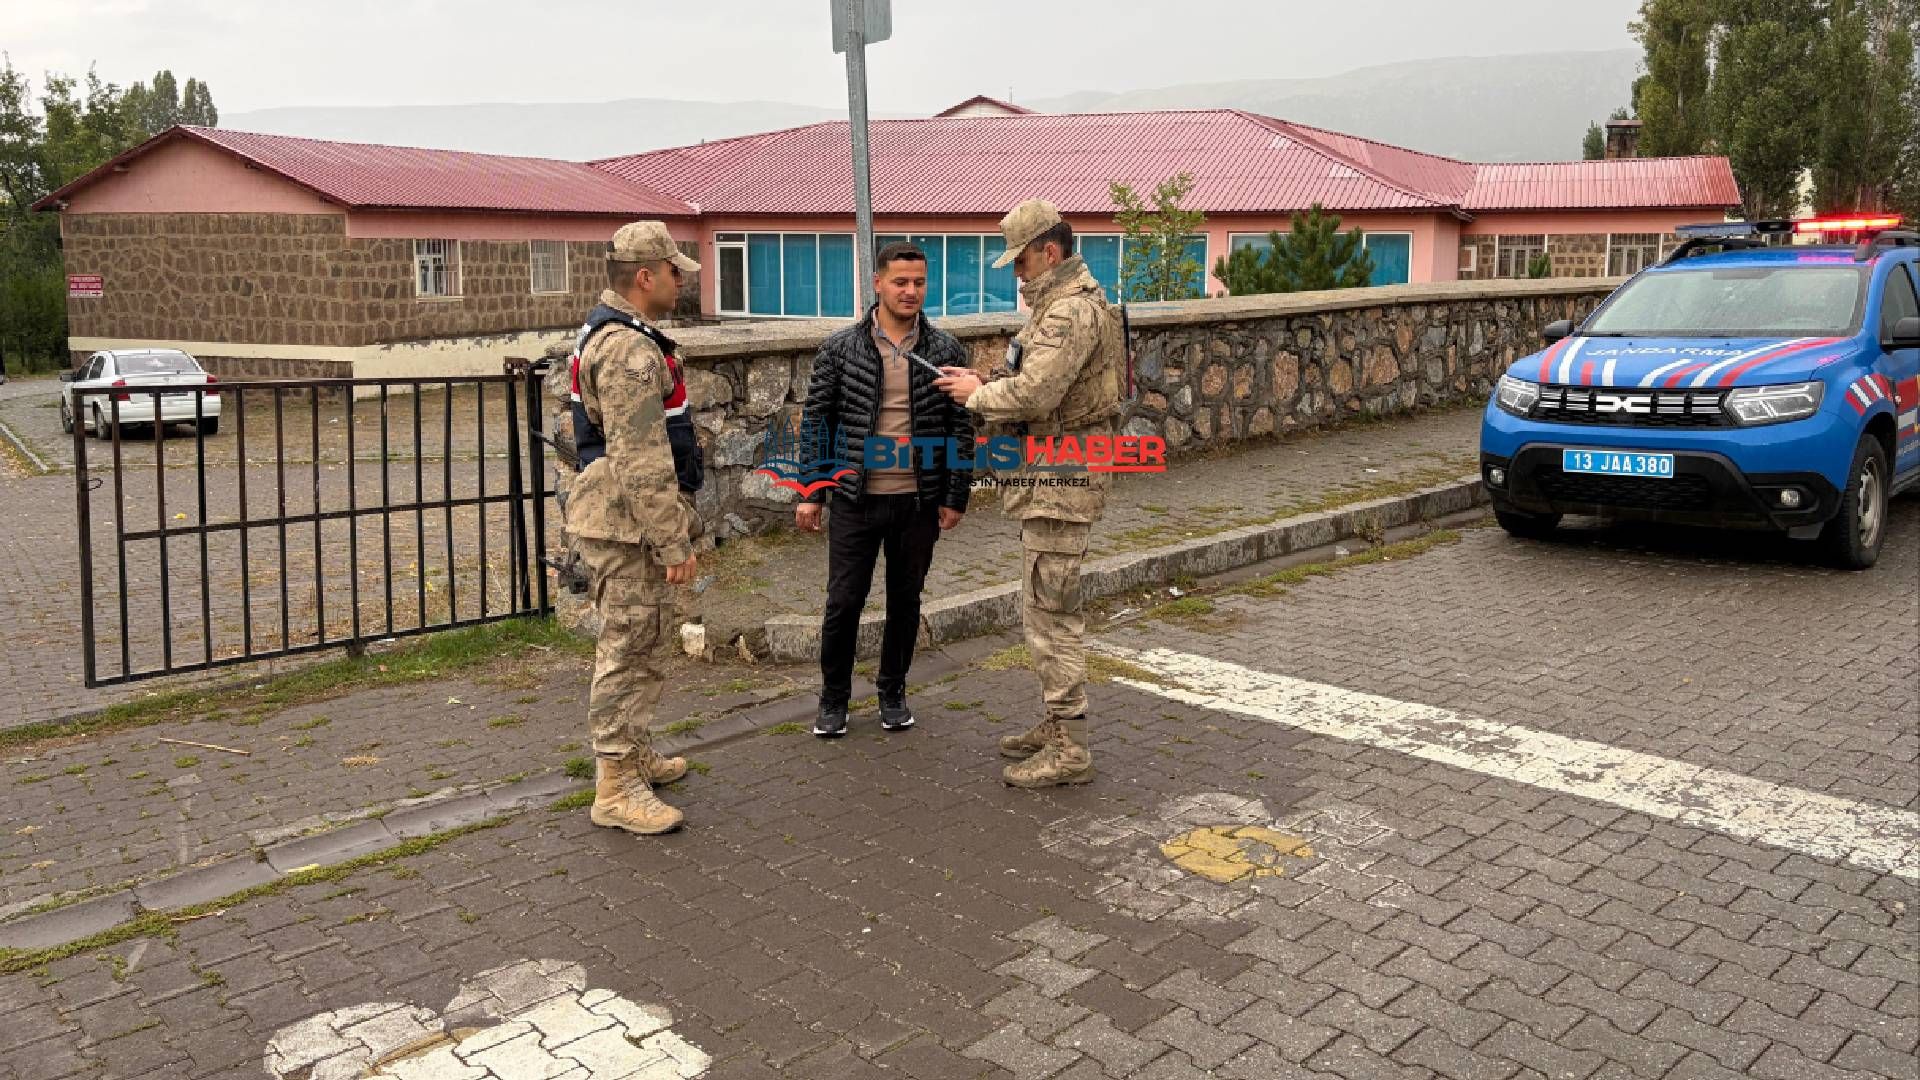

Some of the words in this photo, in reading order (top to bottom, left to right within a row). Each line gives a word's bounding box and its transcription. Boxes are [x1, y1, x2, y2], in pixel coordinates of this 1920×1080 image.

[1585, 347, 1746, 356] JANDARMA
[1574, 453, 1592, 470] 13
[1601, 454, 1632, 473] JAA
[1636, 456, 1670, 474] 380
